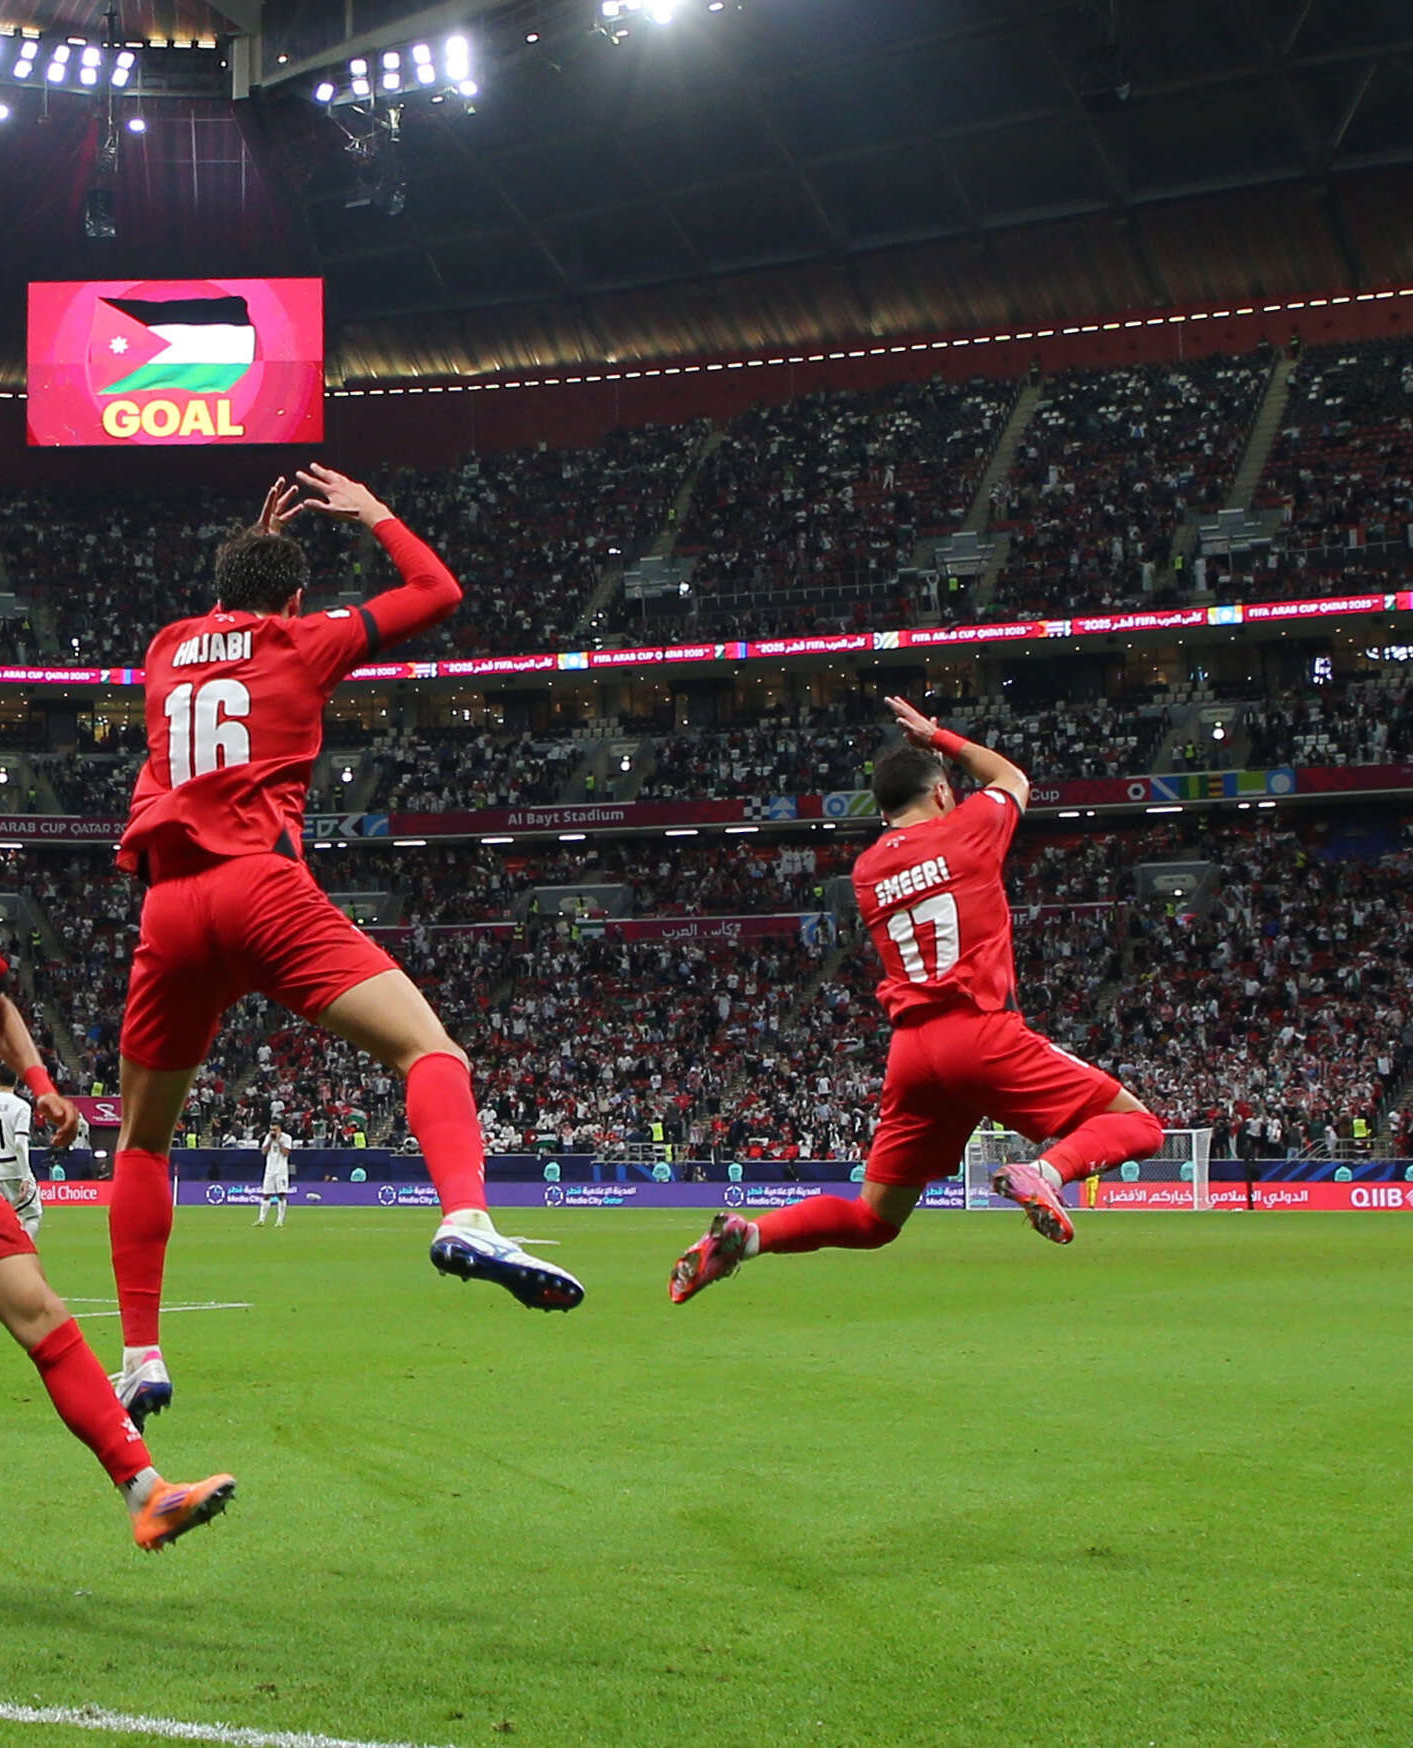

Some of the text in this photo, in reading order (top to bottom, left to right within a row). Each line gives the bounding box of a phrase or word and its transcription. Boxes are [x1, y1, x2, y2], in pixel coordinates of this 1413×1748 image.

[102, 400, 244, 438] GOAL
[1248, 608, 1270, 618] FIFA
[1271, 606, 1298, 616] ARAB
[1299, 604, 1318, 614] CUP
[912, 633, 931, 642] FIFA
[958, 630, 975, 639] CUP
[594, 654, 611, 663] FIFA
[613, 652, 636, 662] ARAB
[638, 652, 654, 660] CUP
[3, 670, 26, 678] ARAB
[28, 671, 44, 679] CUP
[165, 678, 250, 789] 16
[1030, 788, 1060, 802] Cup
[508, 809, 624, 826] Al Bayt Stadium
[40, 822, 66, 833] CUP
[70, 823, 109, 835] QATAR
[875, 856, 950, 907] SMEERI
[887, 892, 960, 983] 17
[58, 1185, 98, 1200] Choice
[398, 1195, 418, 1203] Media
[1148, 1190, 1193, 1205] خياركم
[1263, 1190, 1308, 1208] الدولي
[1352, 1189, 1403, 1208] QIIB
[566, 1196, 588, 1204] Media
[588, 1197, 602, 1206] City
[746, 1197, 770, 1205] Media
[770, 1197, 784, 1206] City
